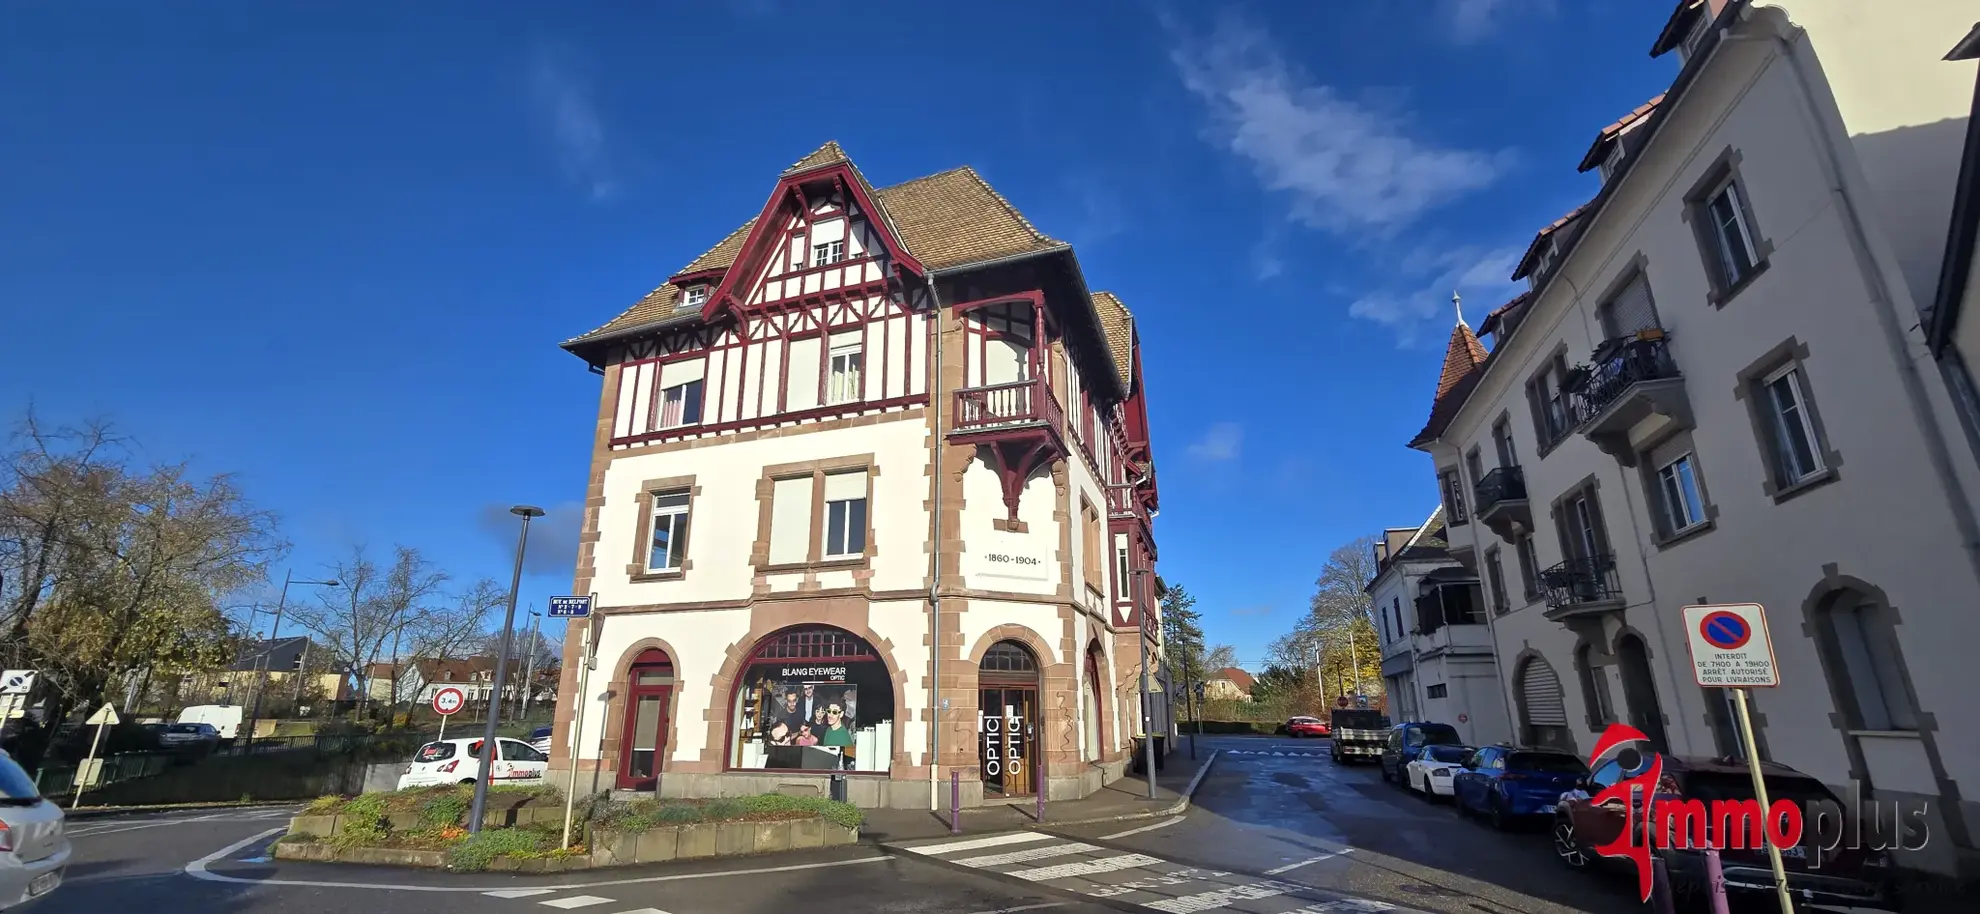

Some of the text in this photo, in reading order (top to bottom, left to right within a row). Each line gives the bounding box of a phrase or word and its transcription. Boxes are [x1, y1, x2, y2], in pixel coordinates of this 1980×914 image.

[782, 667, 846, 676] BLANG EYEWEAR
[1703, 667, 1768, 676] ARRÊT AUTORISÉ
